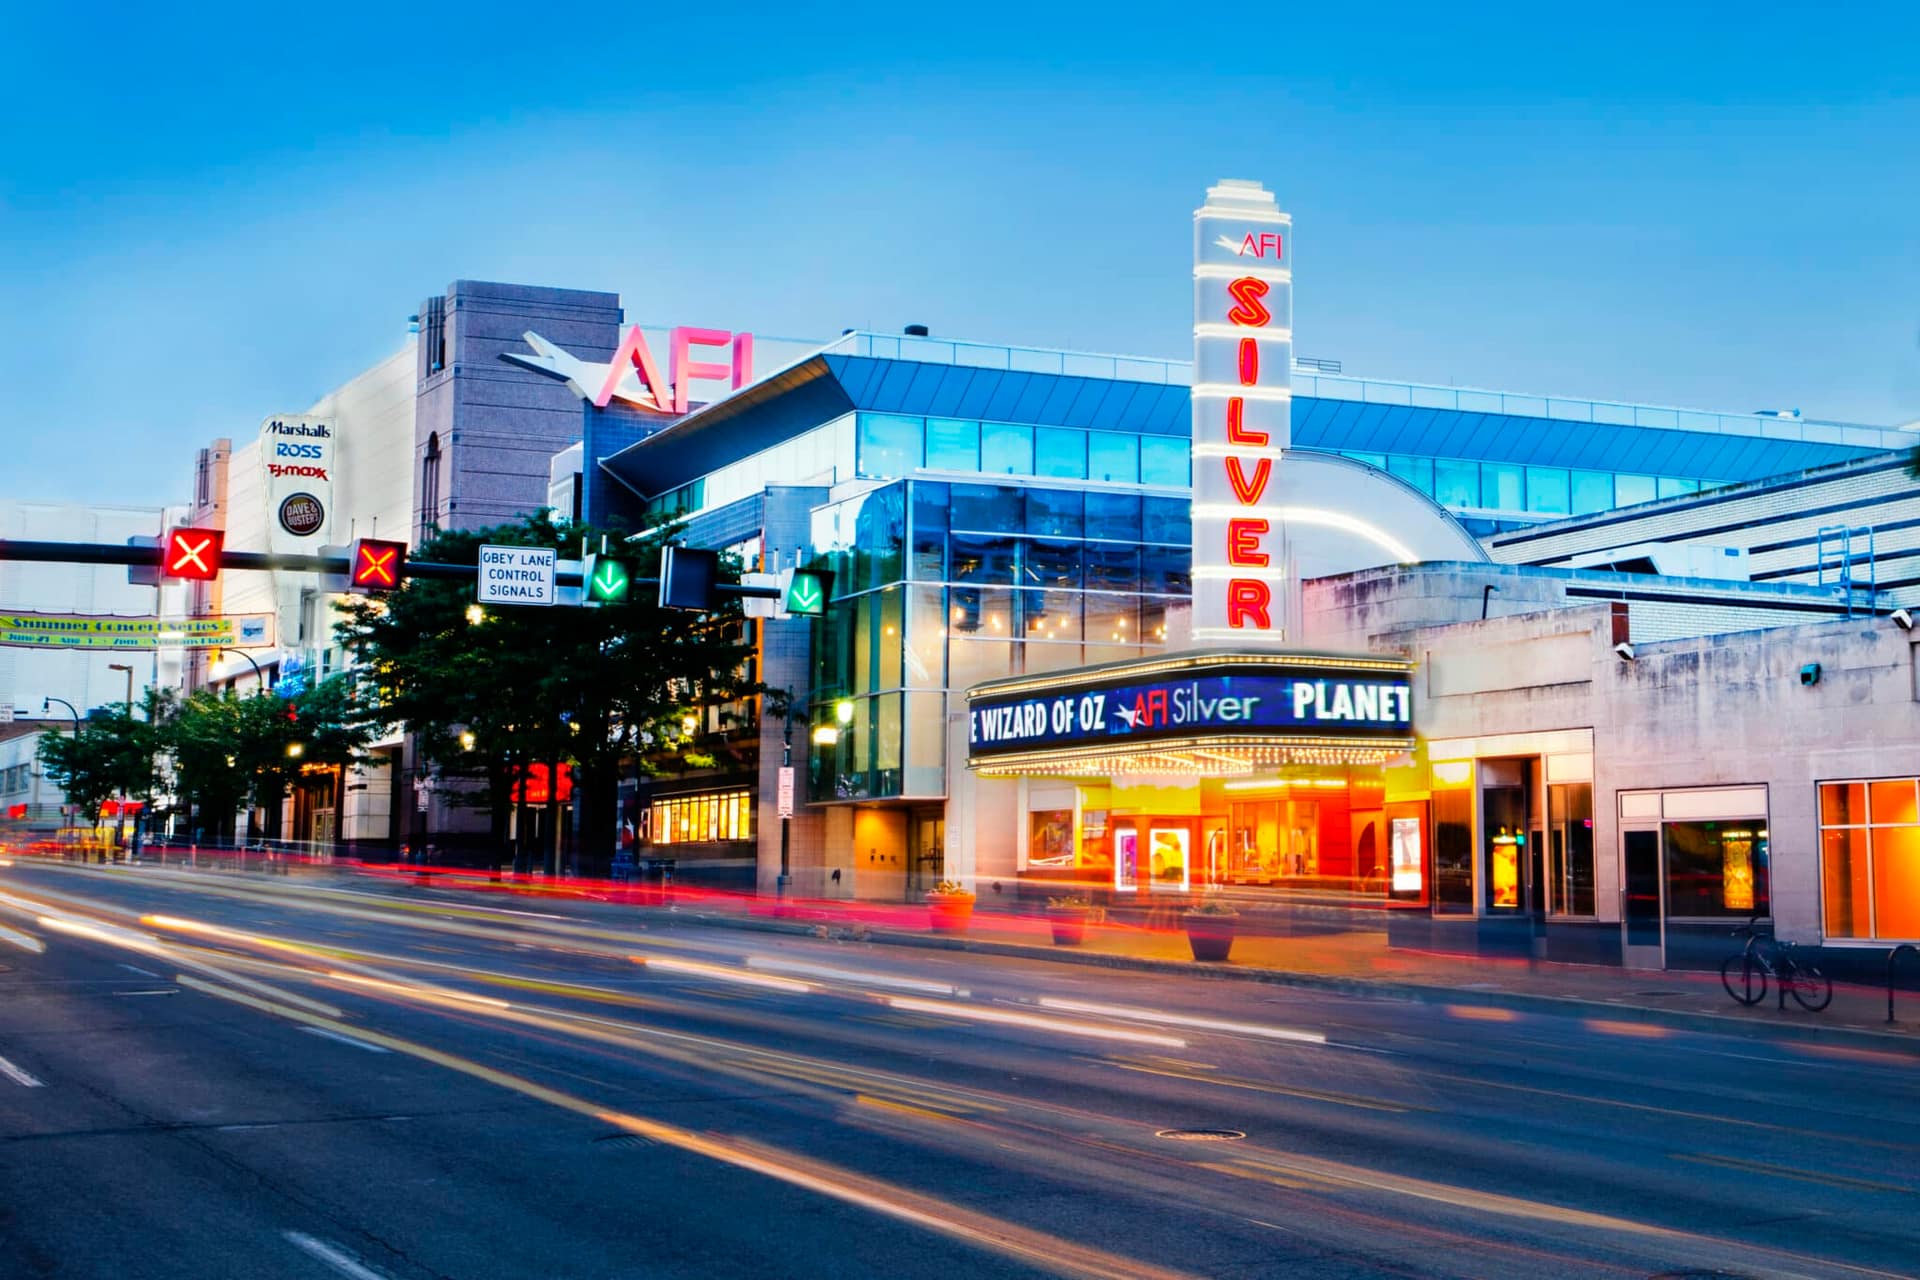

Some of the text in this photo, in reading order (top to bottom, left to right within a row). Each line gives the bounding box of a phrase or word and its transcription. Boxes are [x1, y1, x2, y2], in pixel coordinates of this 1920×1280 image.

[1239, 232, 1281, 260] AFI
[593, 322, 753, 414] AFI
[266, 420, 331, 438] Marshalls
[276, 443, 322, 459] ROSS
[1226, 276, 1271, 630] SILVER
[286, 502, 318, 516] DAVE &
[483, 552, 552, 567] OBEY LANE
[489, 569, 544, 582] CONTROL
[490, 585, 544, 598] SIGNALS
[981, 703, 1047, 742] WIZARD
[1052, 698, 1075, 734] OF
[1079, 694, 1106, 730] OZ
[1131, 689, 1168, 728] AFI
[1172, 681, 1260, 725] Silver
[1293, 682, 1411, 722] PLANET
